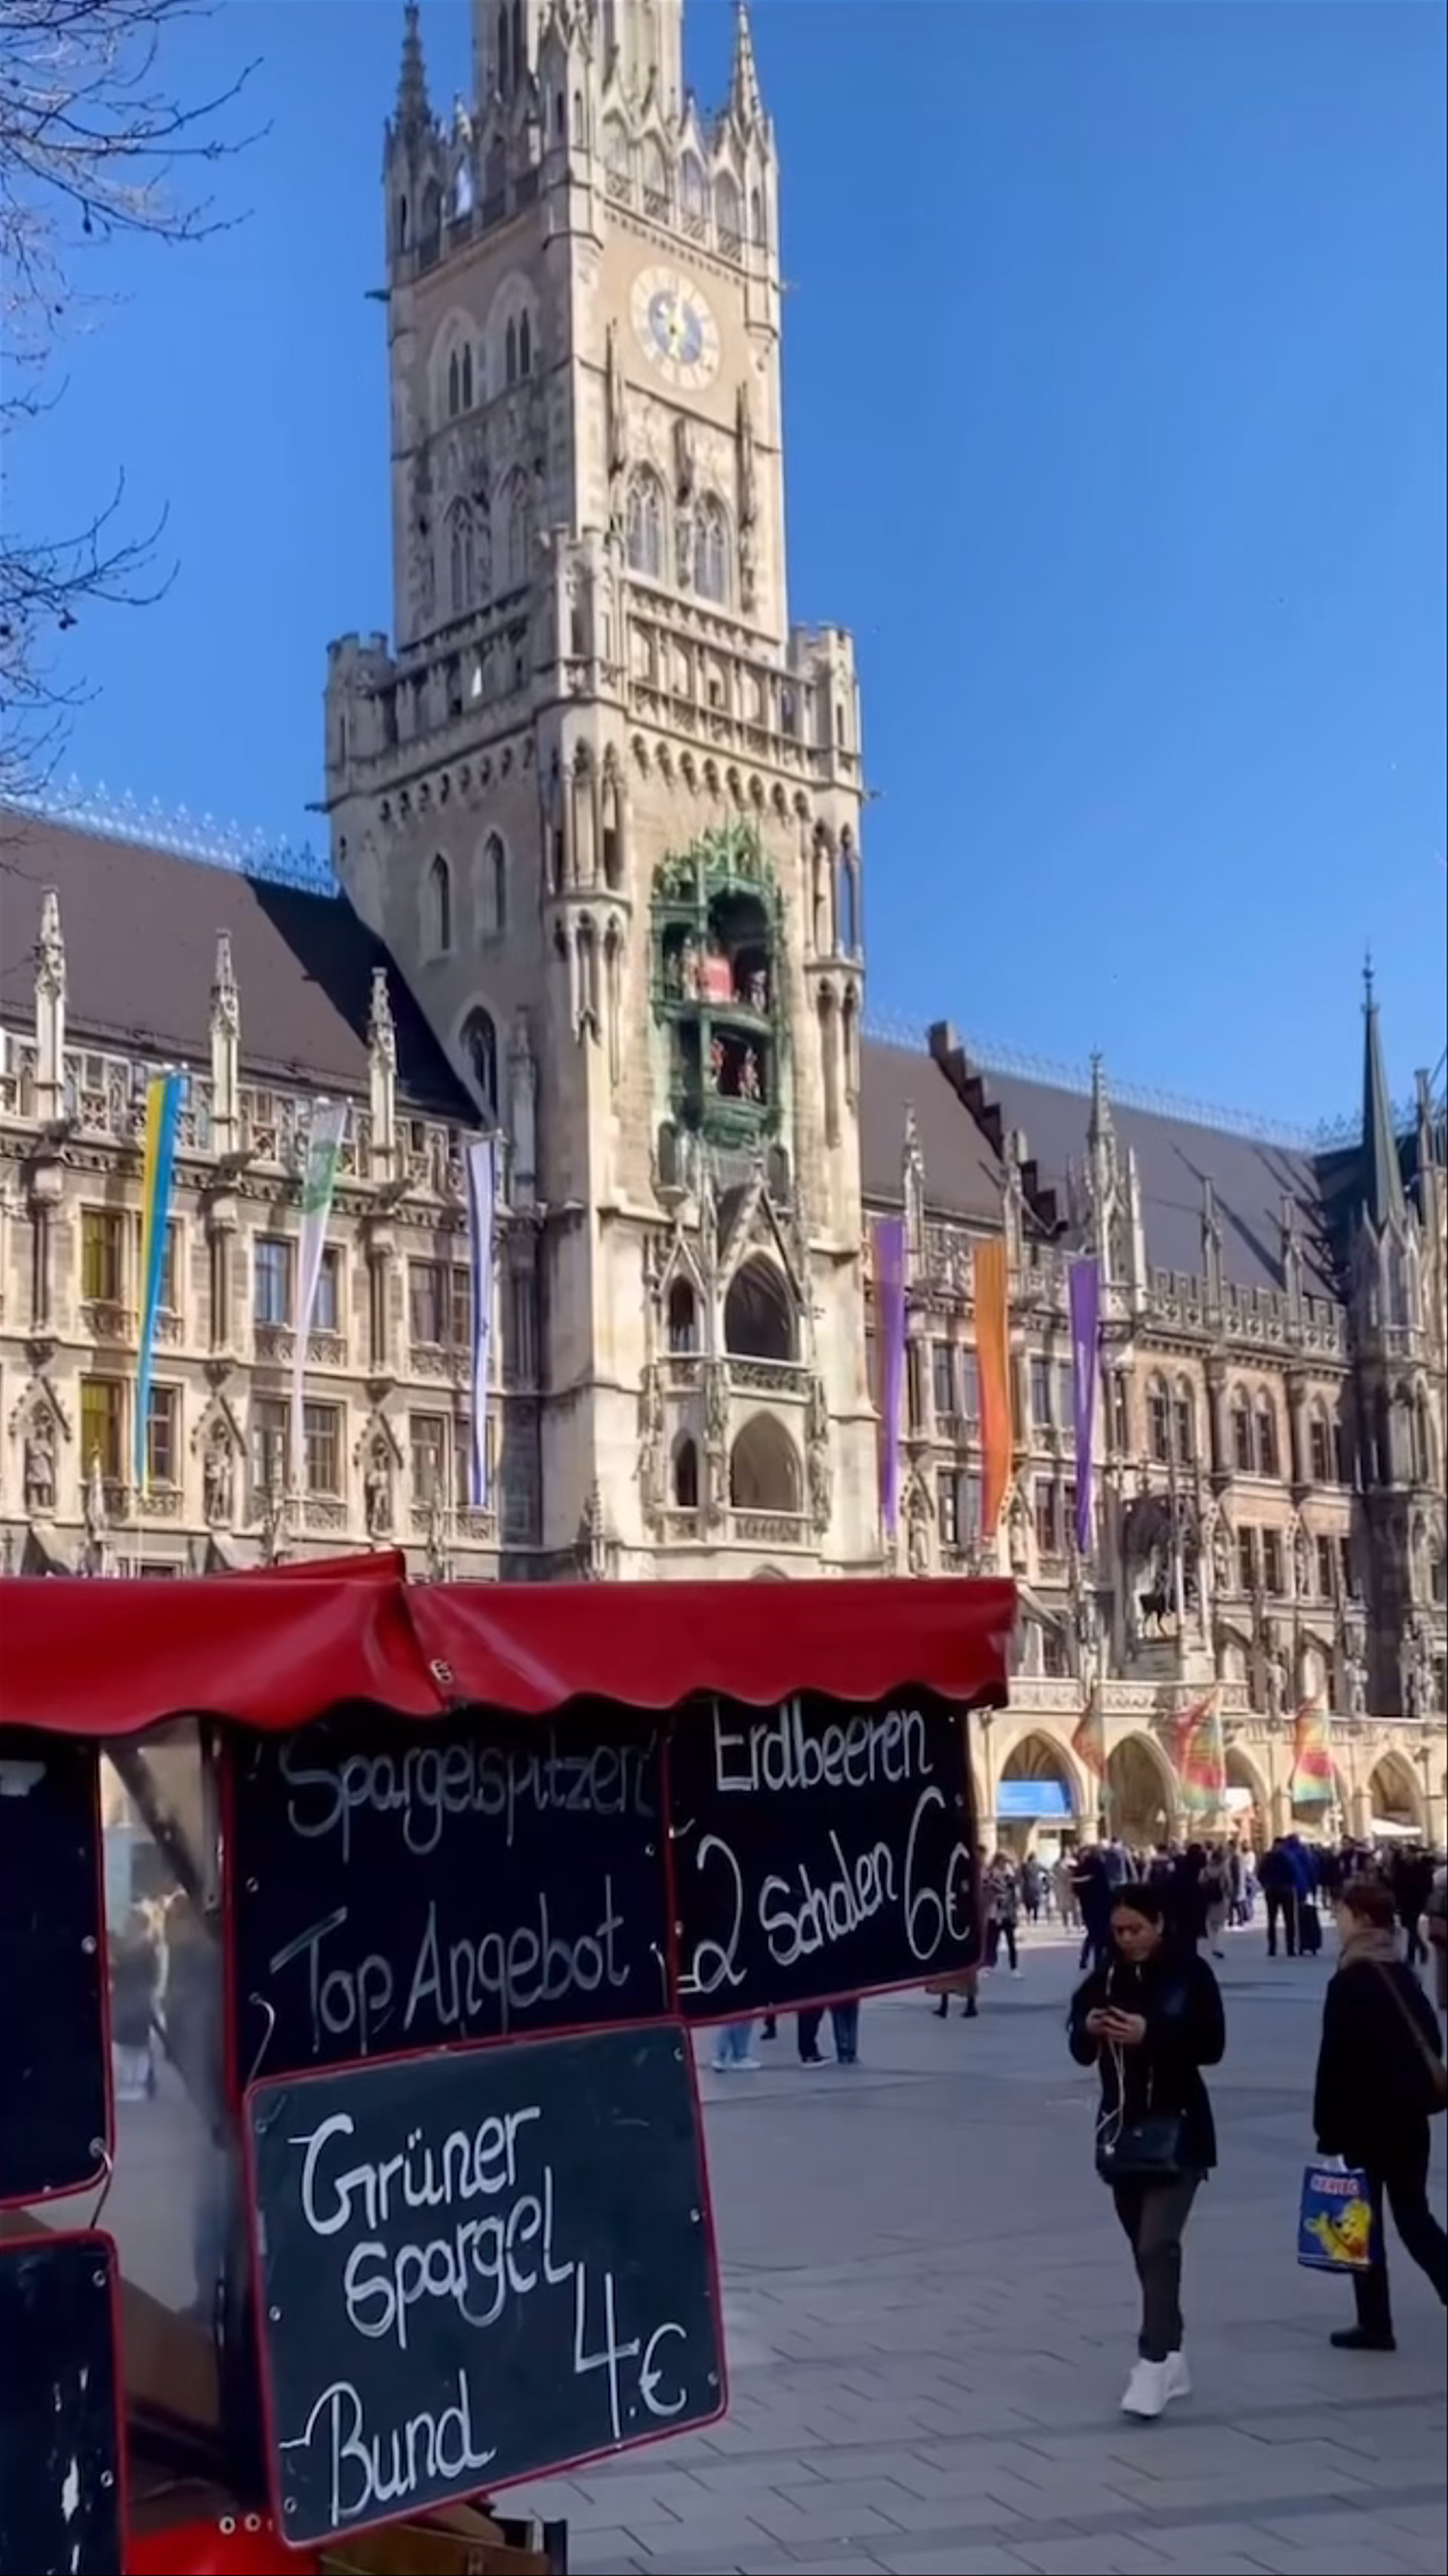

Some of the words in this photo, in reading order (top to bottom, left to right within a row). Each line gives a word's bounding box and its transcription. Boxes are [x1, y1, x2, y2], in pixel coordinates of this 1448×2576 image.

[278, 1723, 655, 1863] Spargelspitzen
[711, 1697, 933, 1791] Erdbeeren
[270, 1906, 394, 2056] Top
[404, 1874, 630, 2038] Angebot
[678, 1834, 747, 1993] 2
[759, 1830, 898, 1966] Schalen
[288, 2107, 540, 2234] Grüner
[344, 2166, 574, 2349] Spargel
[279, 2369, 496, 2526] Bund
